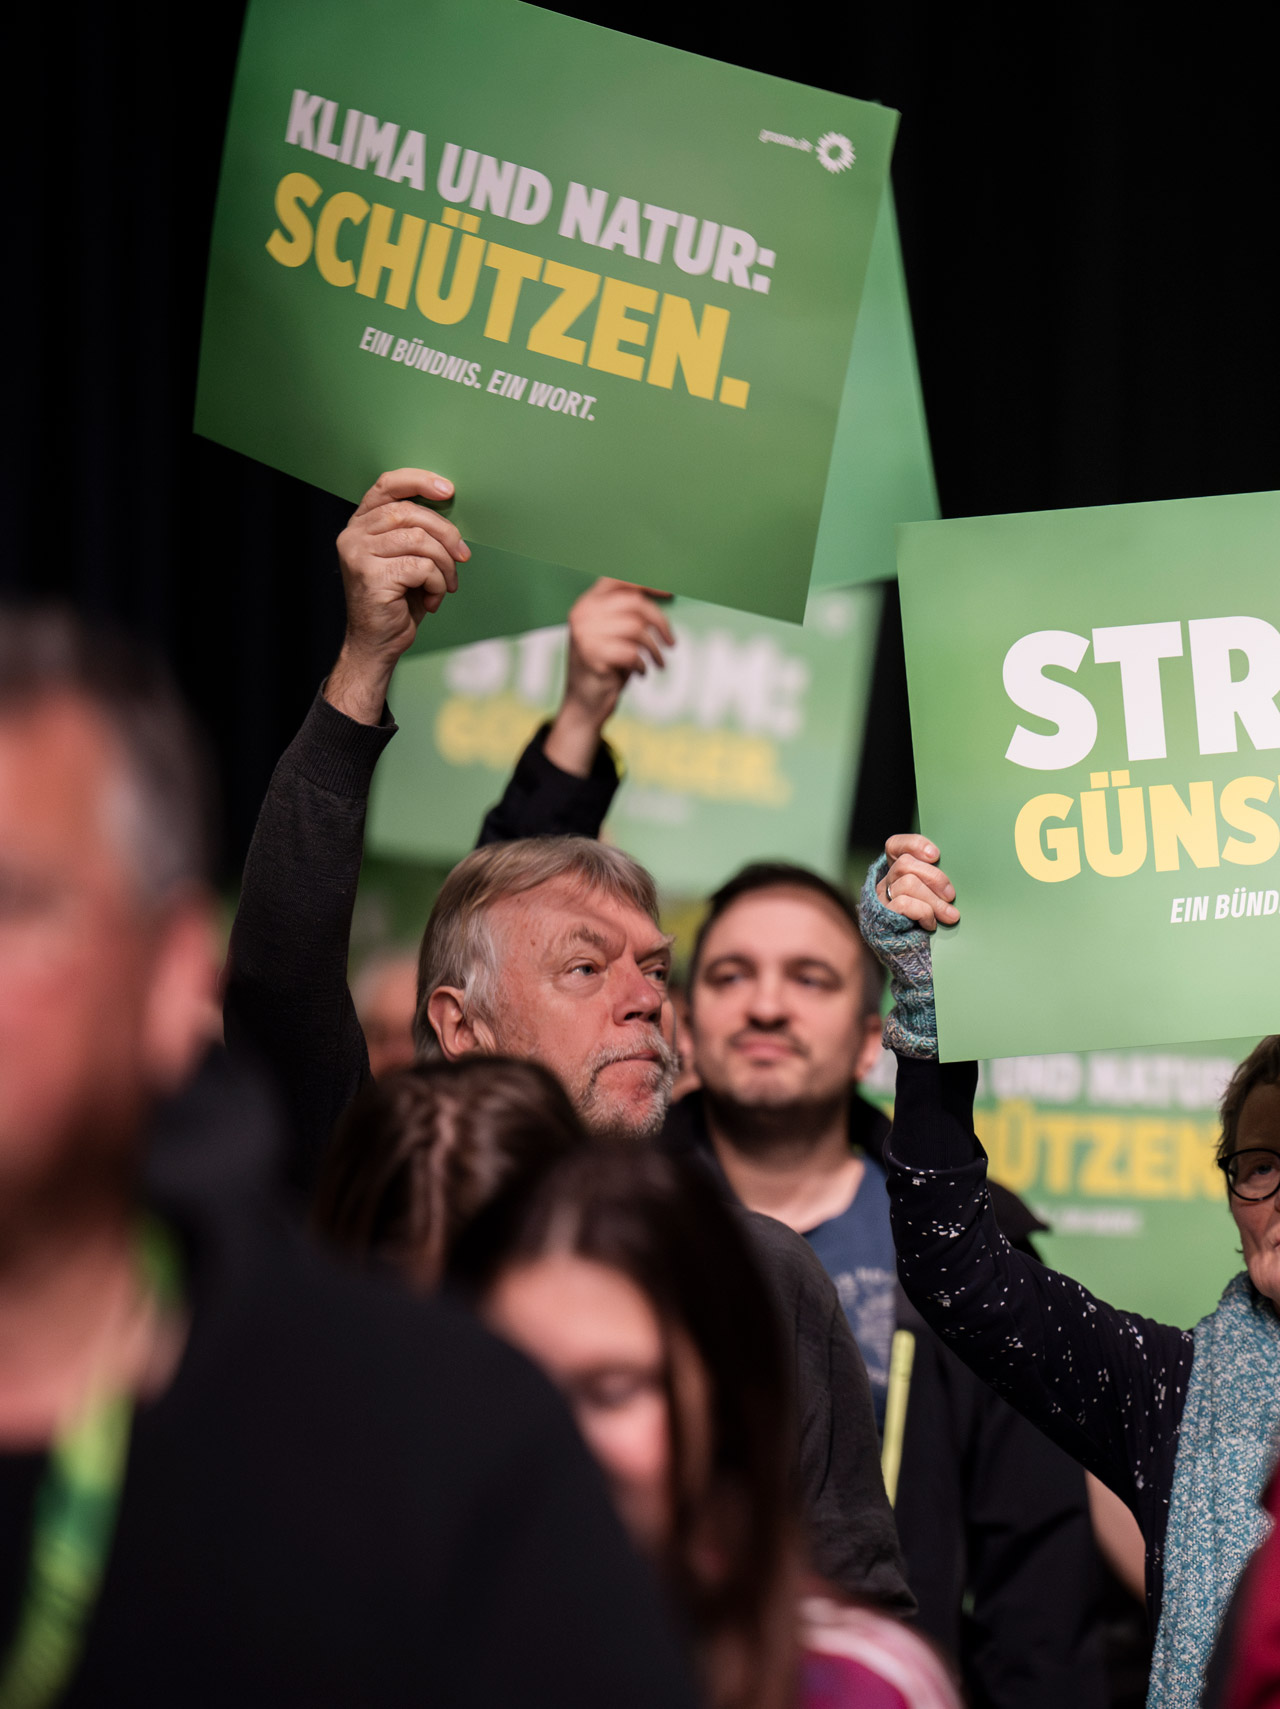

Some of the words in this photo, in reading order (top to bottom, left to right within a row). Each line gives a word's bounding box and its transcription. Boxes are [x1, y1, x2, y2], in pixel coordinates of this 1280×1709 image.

[284, 88, 427, 192] KLIMA
[436, 142, 553, 226] UND
[558, 181, 777, 295] NATUR:
[265, 172, 751, 410] SCHÜTZEN.
[359, 326, 394, 357] EIN
[390, 337, 482, 389] BÜNDNIS.
[486, 369, 529, 401] EIN
[527, 380, 598, 423] WORT.
[1170, 895, 1210, 923] EIN
